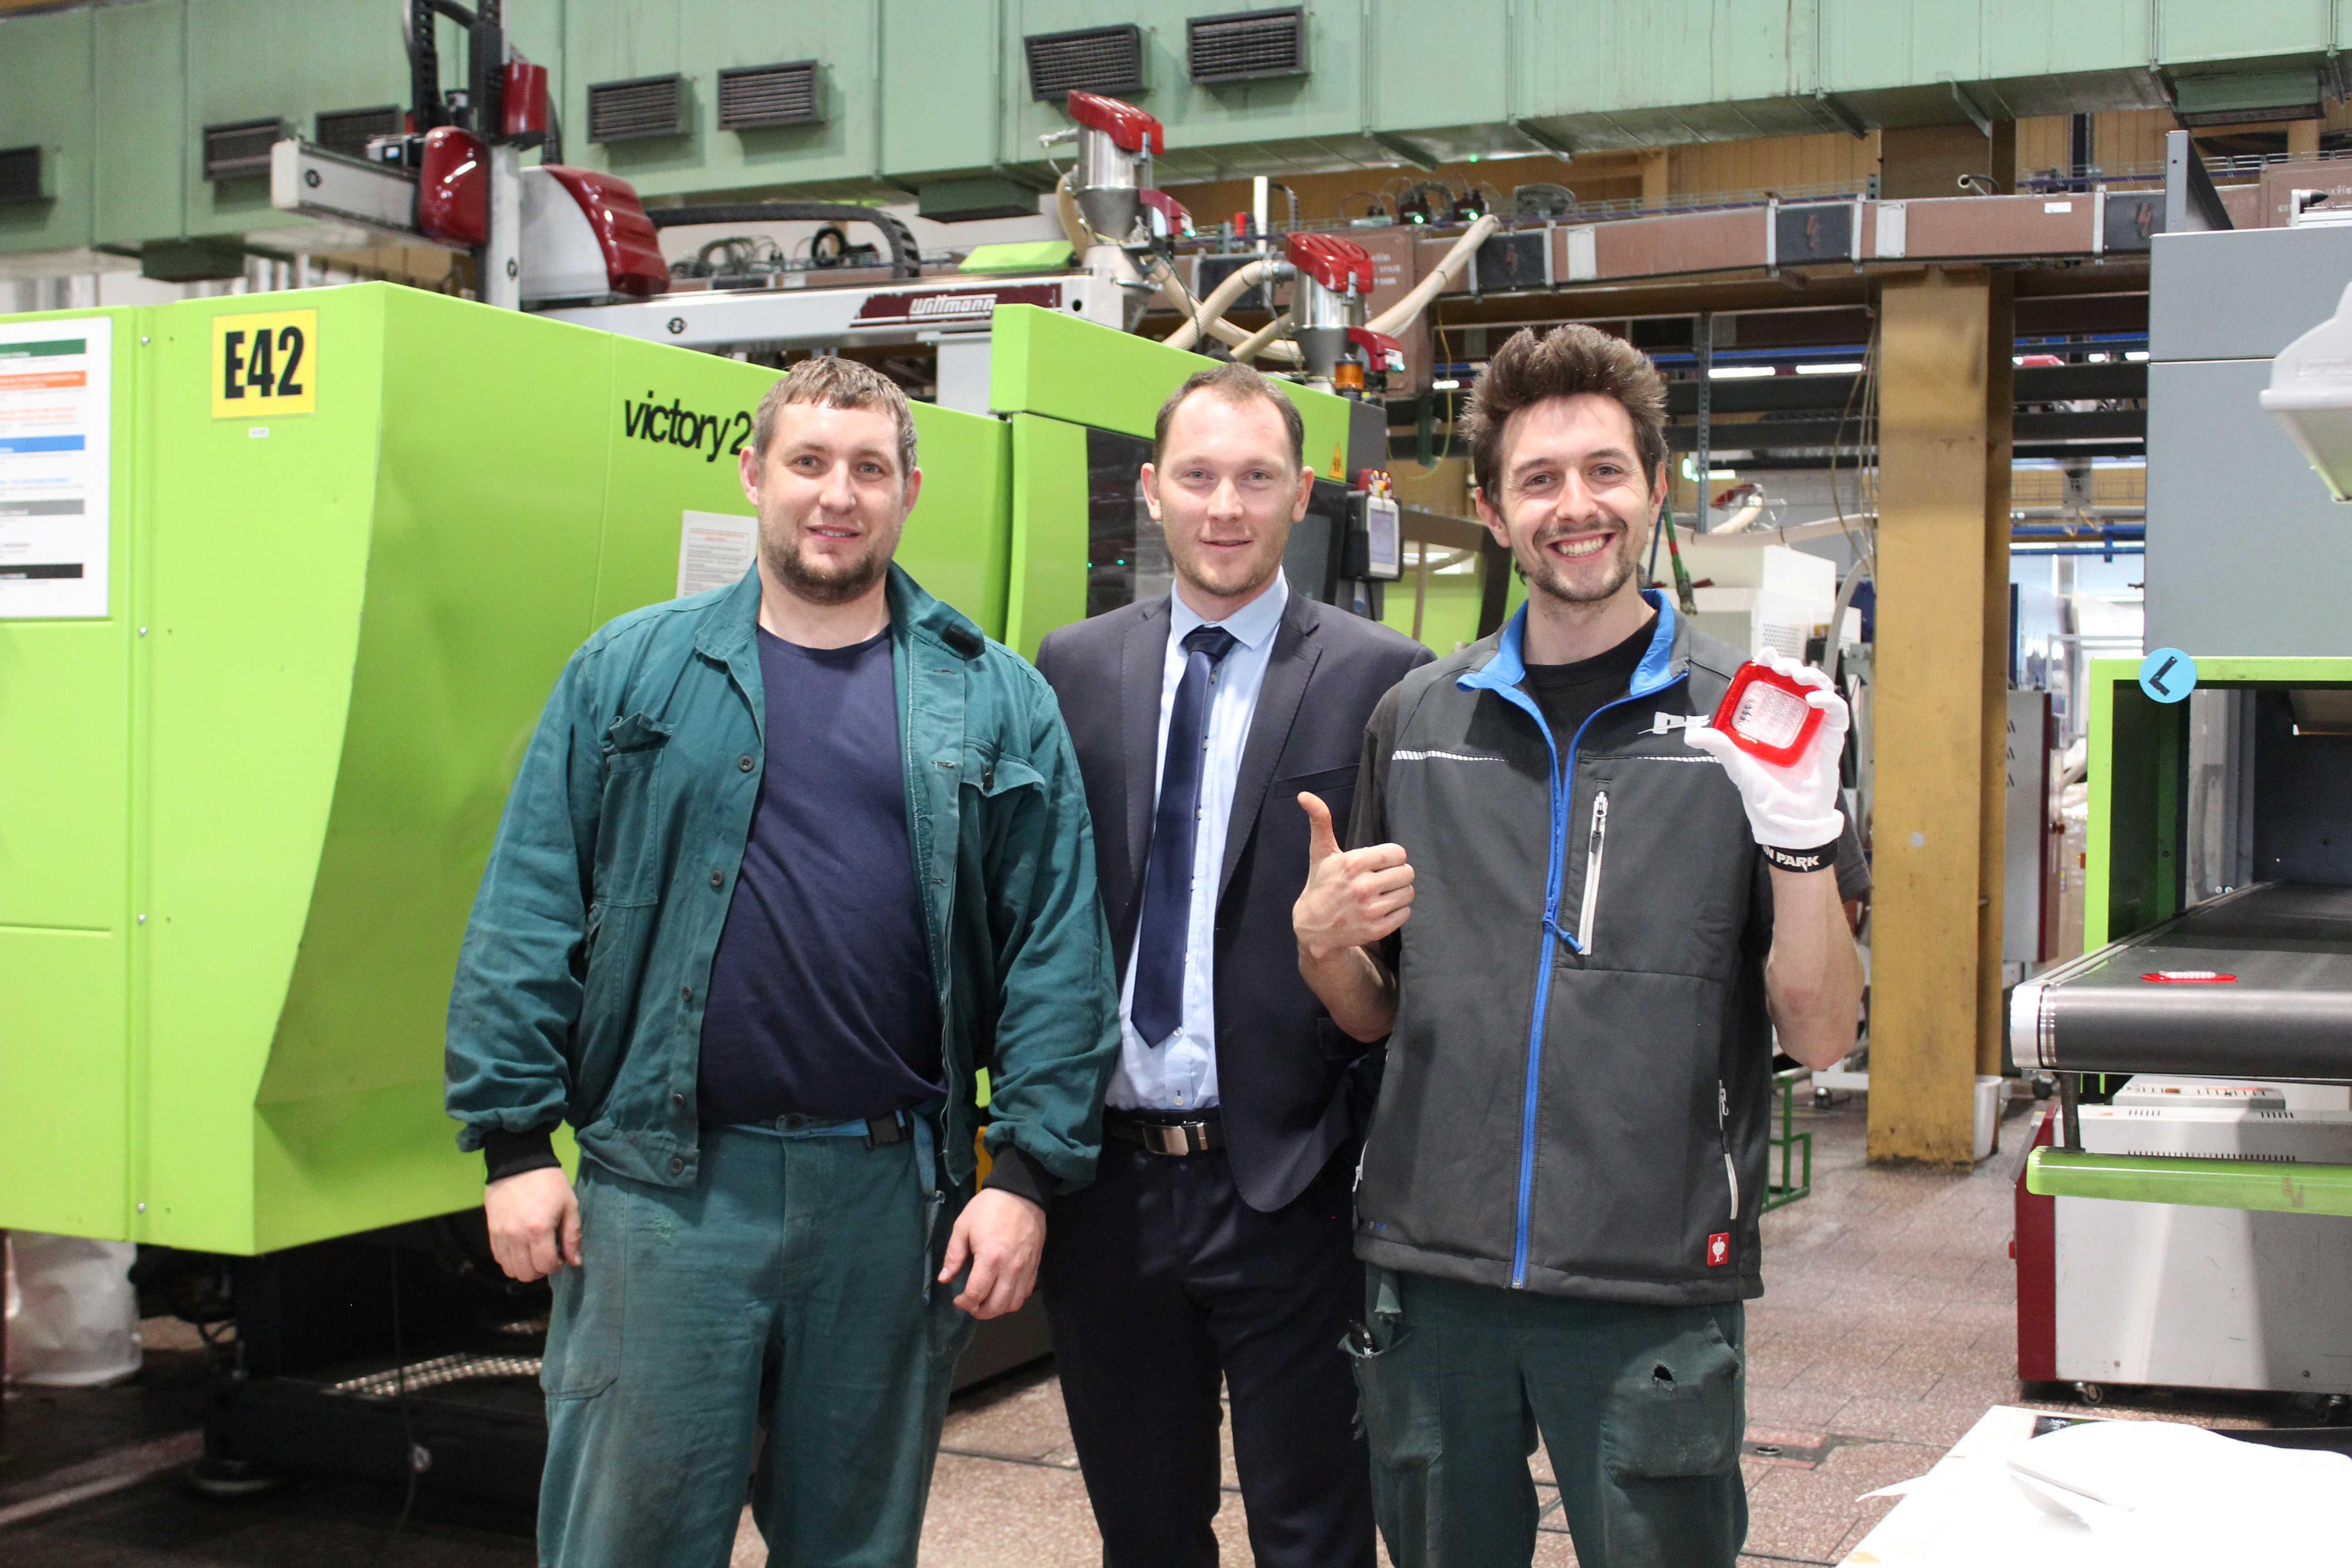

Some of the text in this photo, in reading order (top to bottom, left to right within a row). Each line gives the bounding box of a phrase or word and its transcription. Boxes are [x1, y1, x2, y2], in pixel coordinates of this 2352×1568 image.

[225, 325, 304, 399] E42
[625, 389, 752, 463] victory 2
[1776, 851, 1820, 872] PARK
